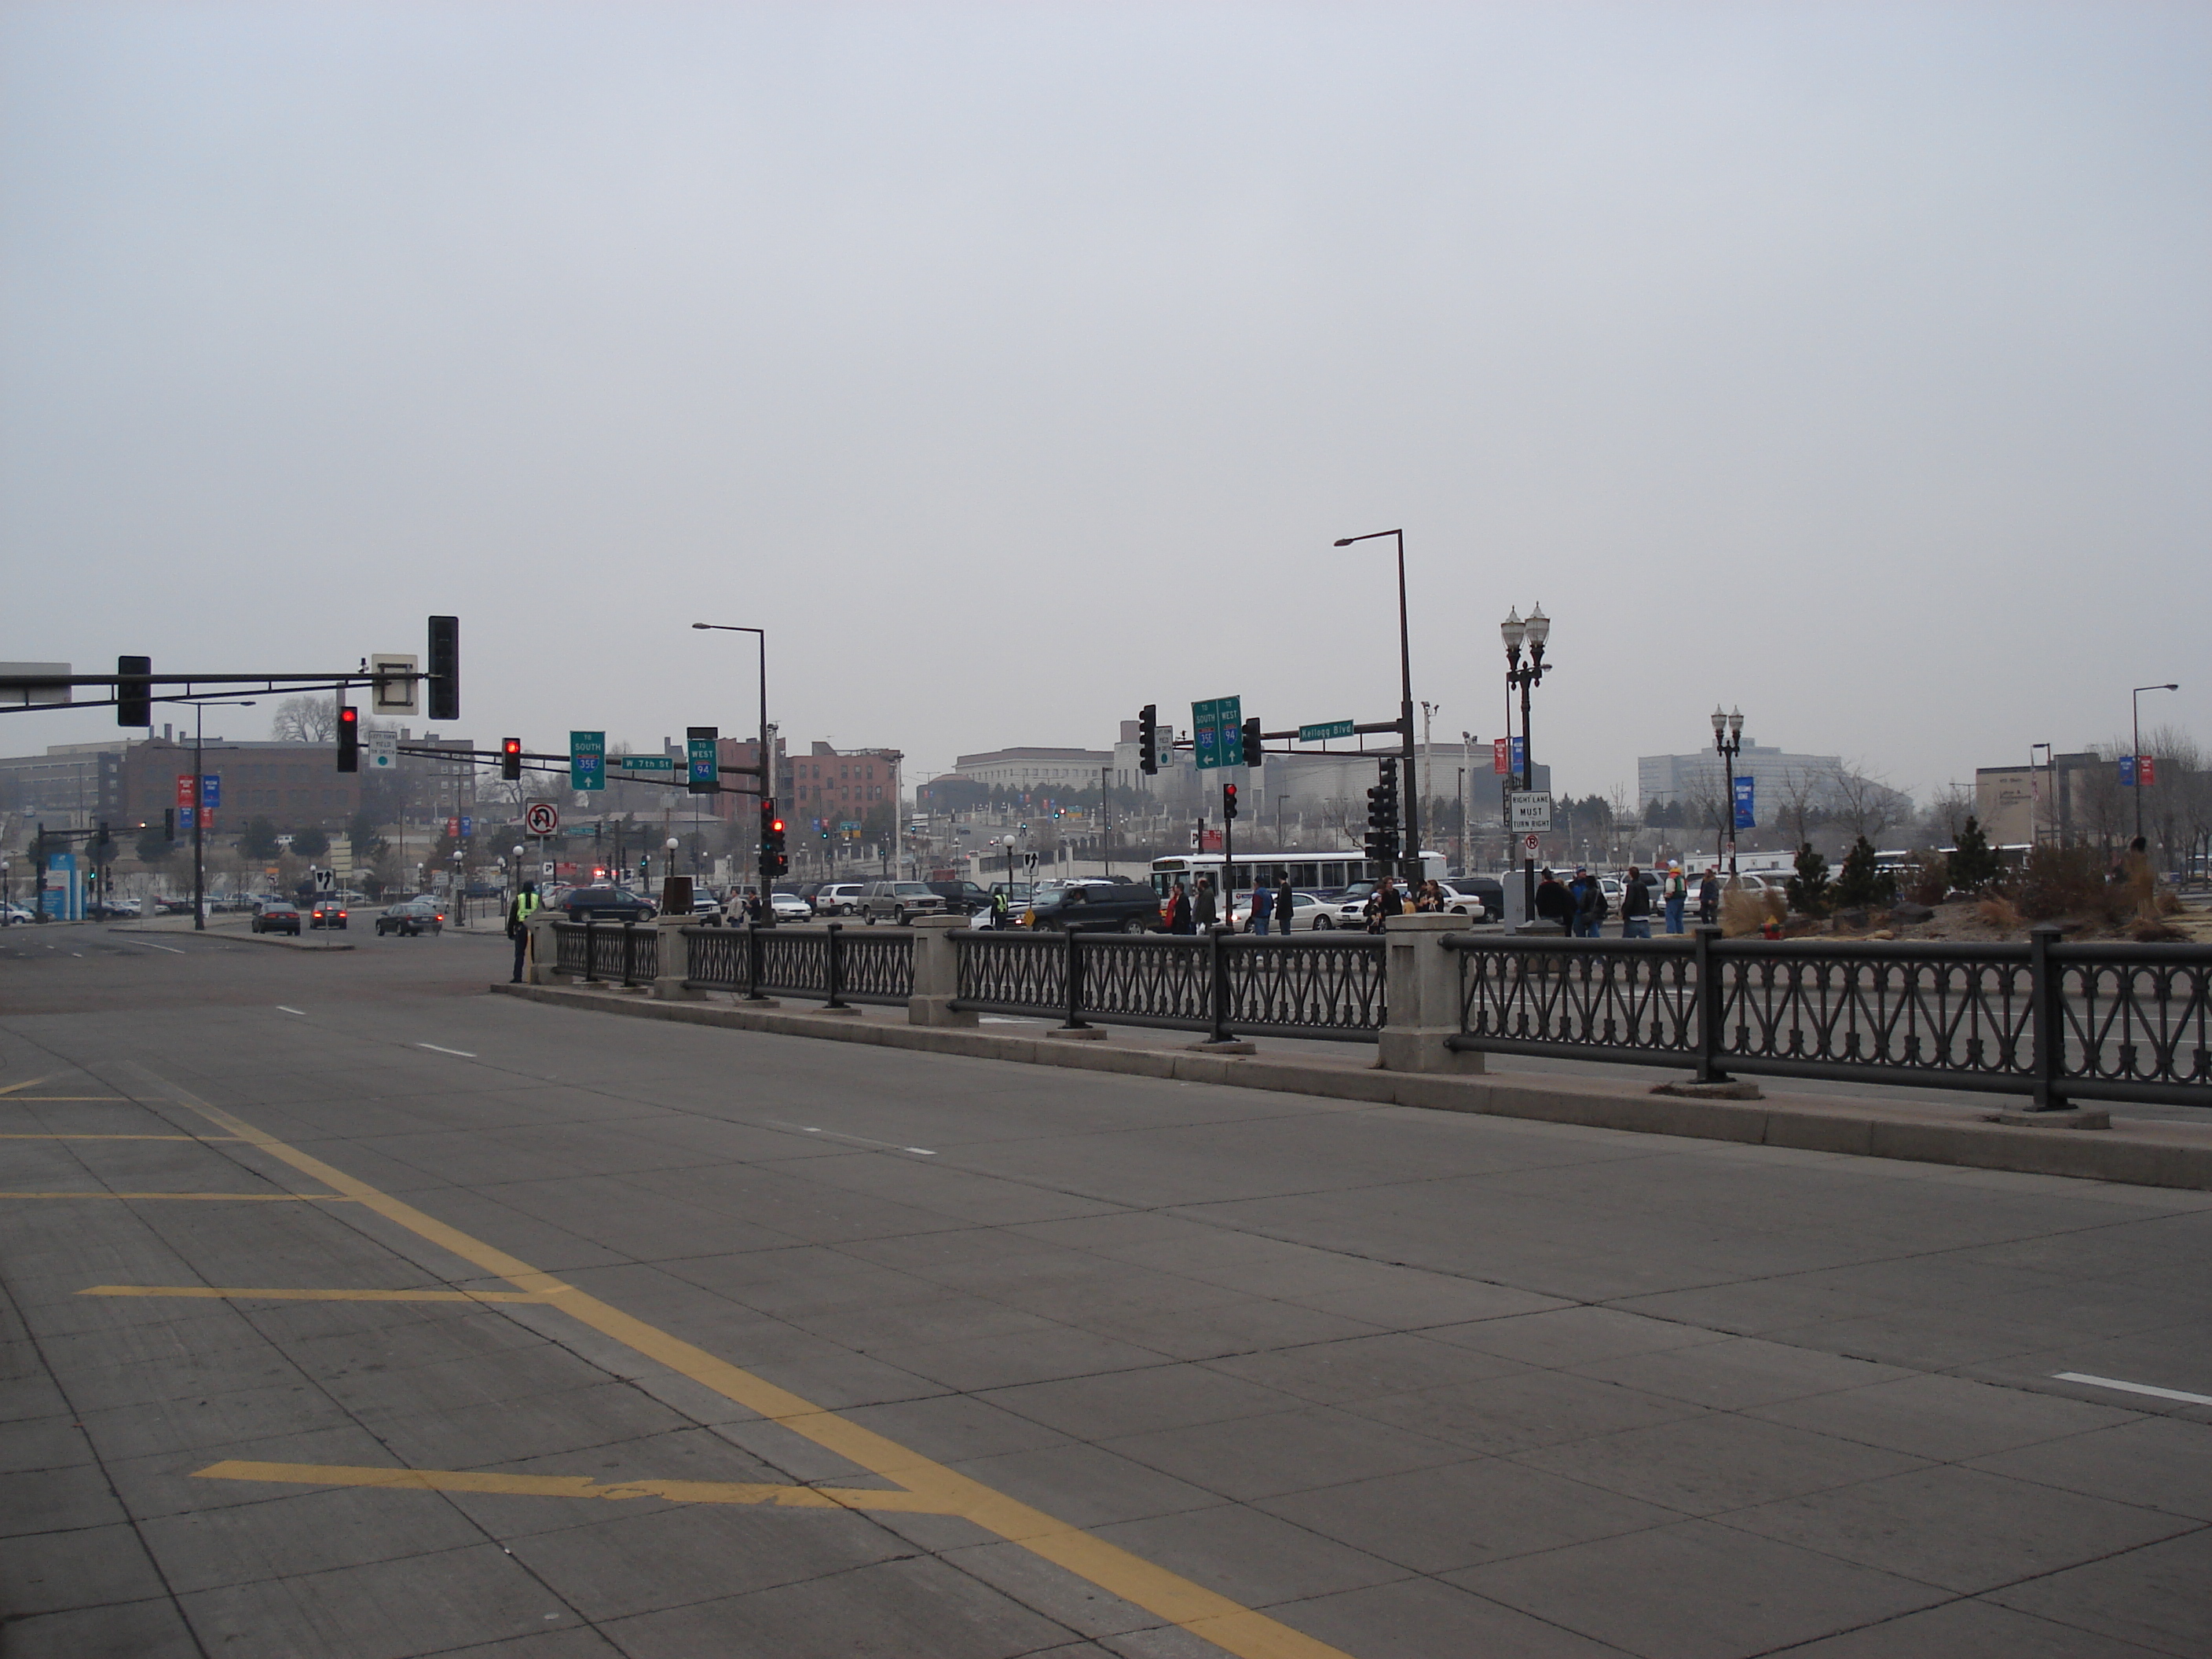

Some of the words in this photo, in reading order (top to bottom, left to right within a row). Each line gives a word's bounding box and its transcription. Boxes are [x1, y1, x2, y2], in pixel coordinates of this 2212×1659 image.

[1196, 713, 1215, 723] SOUTH
[1221, 710, 1237, 720] WEST
[1225, 730, 1236, 741] 94
[1302, 727, 1330, 738] Kellogg
[1333, 723, 1351, 734] Blvd
[1201, 733, 1213, 744] 35E
[575, 742, 601, 751] SOUTH
[580, 759, 595, 769] 35E
[697, 765, 709, 775] 94
